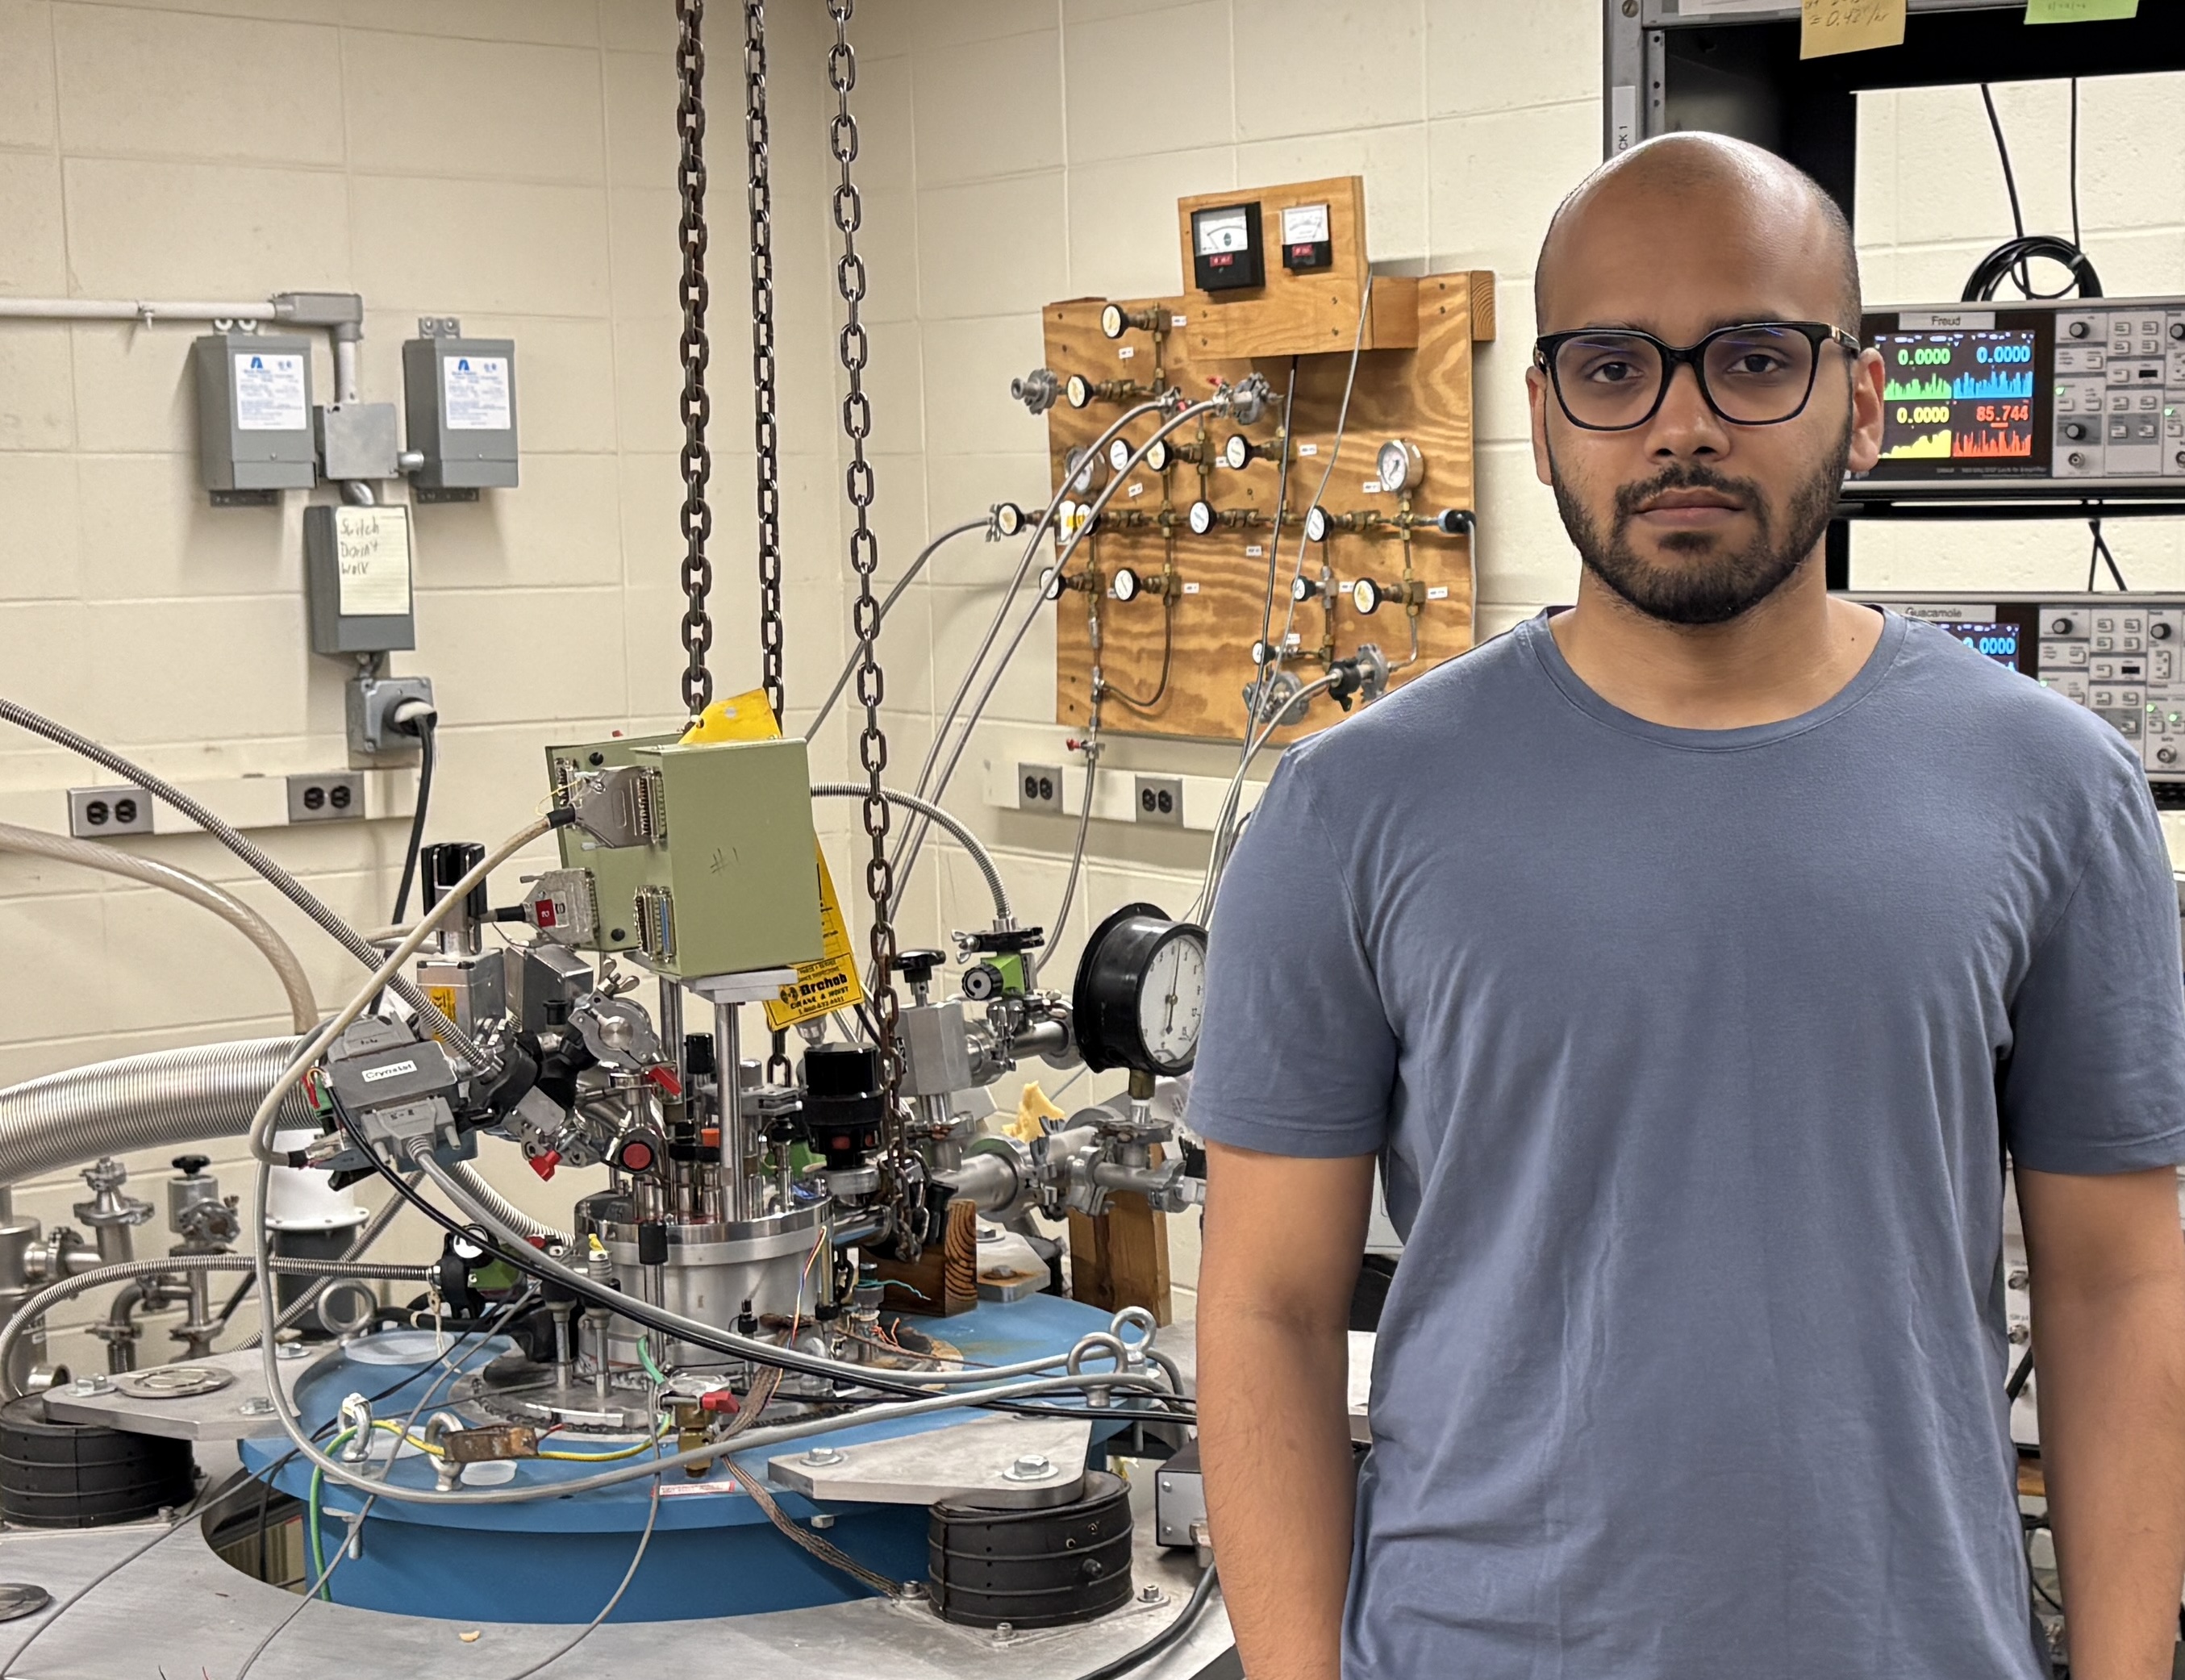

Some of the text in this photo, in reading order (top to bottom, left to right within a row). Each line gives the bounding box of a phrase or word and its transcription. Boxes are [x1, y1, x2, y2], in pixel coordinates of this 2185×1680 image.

[1619, 134, 1628, 151] CK
[1931, 315, 1961, 326] Freud
[1898, 345, 2031, 365] 0.0000 0.0000
[1896, 405, 2029, 423] 0.0000 85.744
[1905, 607, 1962, 618] Guacamole
